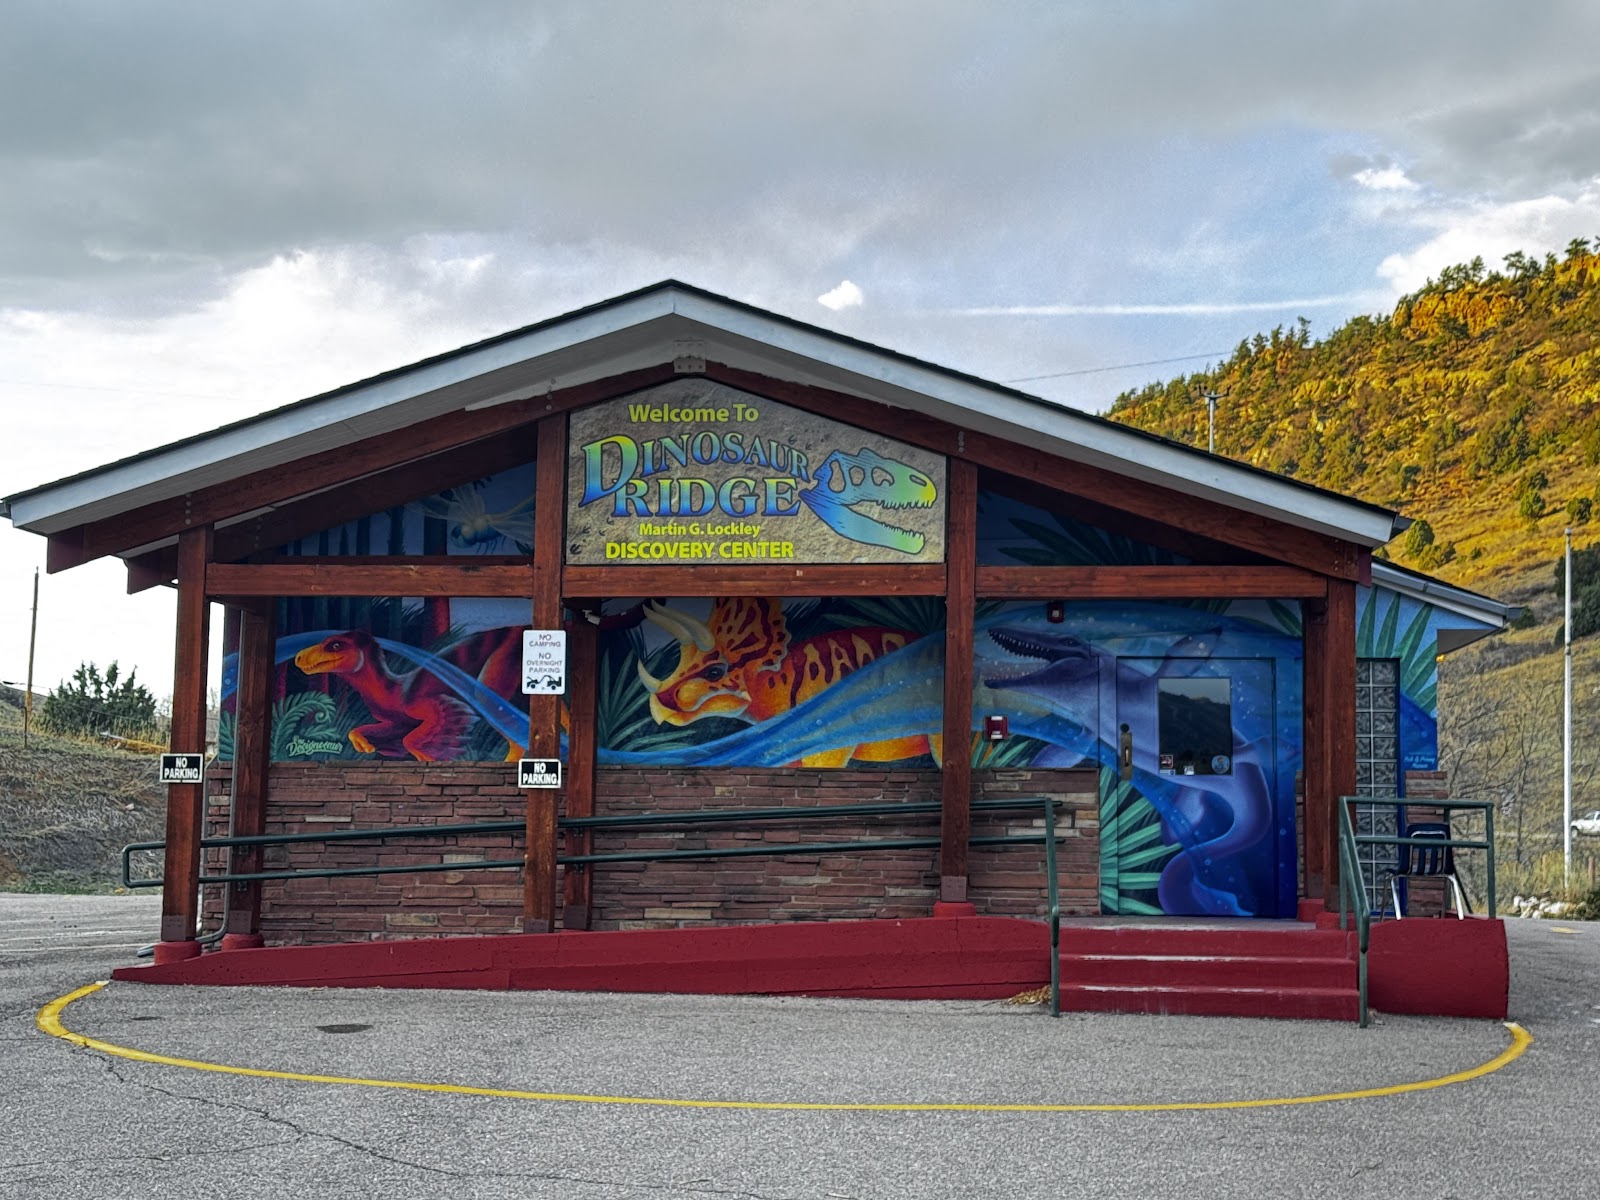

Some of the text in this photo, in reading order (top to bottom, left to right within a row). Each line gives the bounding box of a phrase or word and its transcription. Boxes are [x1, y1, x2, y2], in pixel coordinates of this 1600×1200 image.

[628, 403, 759, 423] Welcome To
[579, 432, 810, 507] DINOSAUR
[611, 477, 801, 518] RIDGE
[639, 522, 760, 538] Martin G. Lockley
[606, 541, 794, 559] DISCOVERY CENTER
[175, 757, 188, 768] NO
[533, 762, 546, 773] NO
[164, 768, 199, 779] PARKING
[522, 773, 557, 784] PARKING
